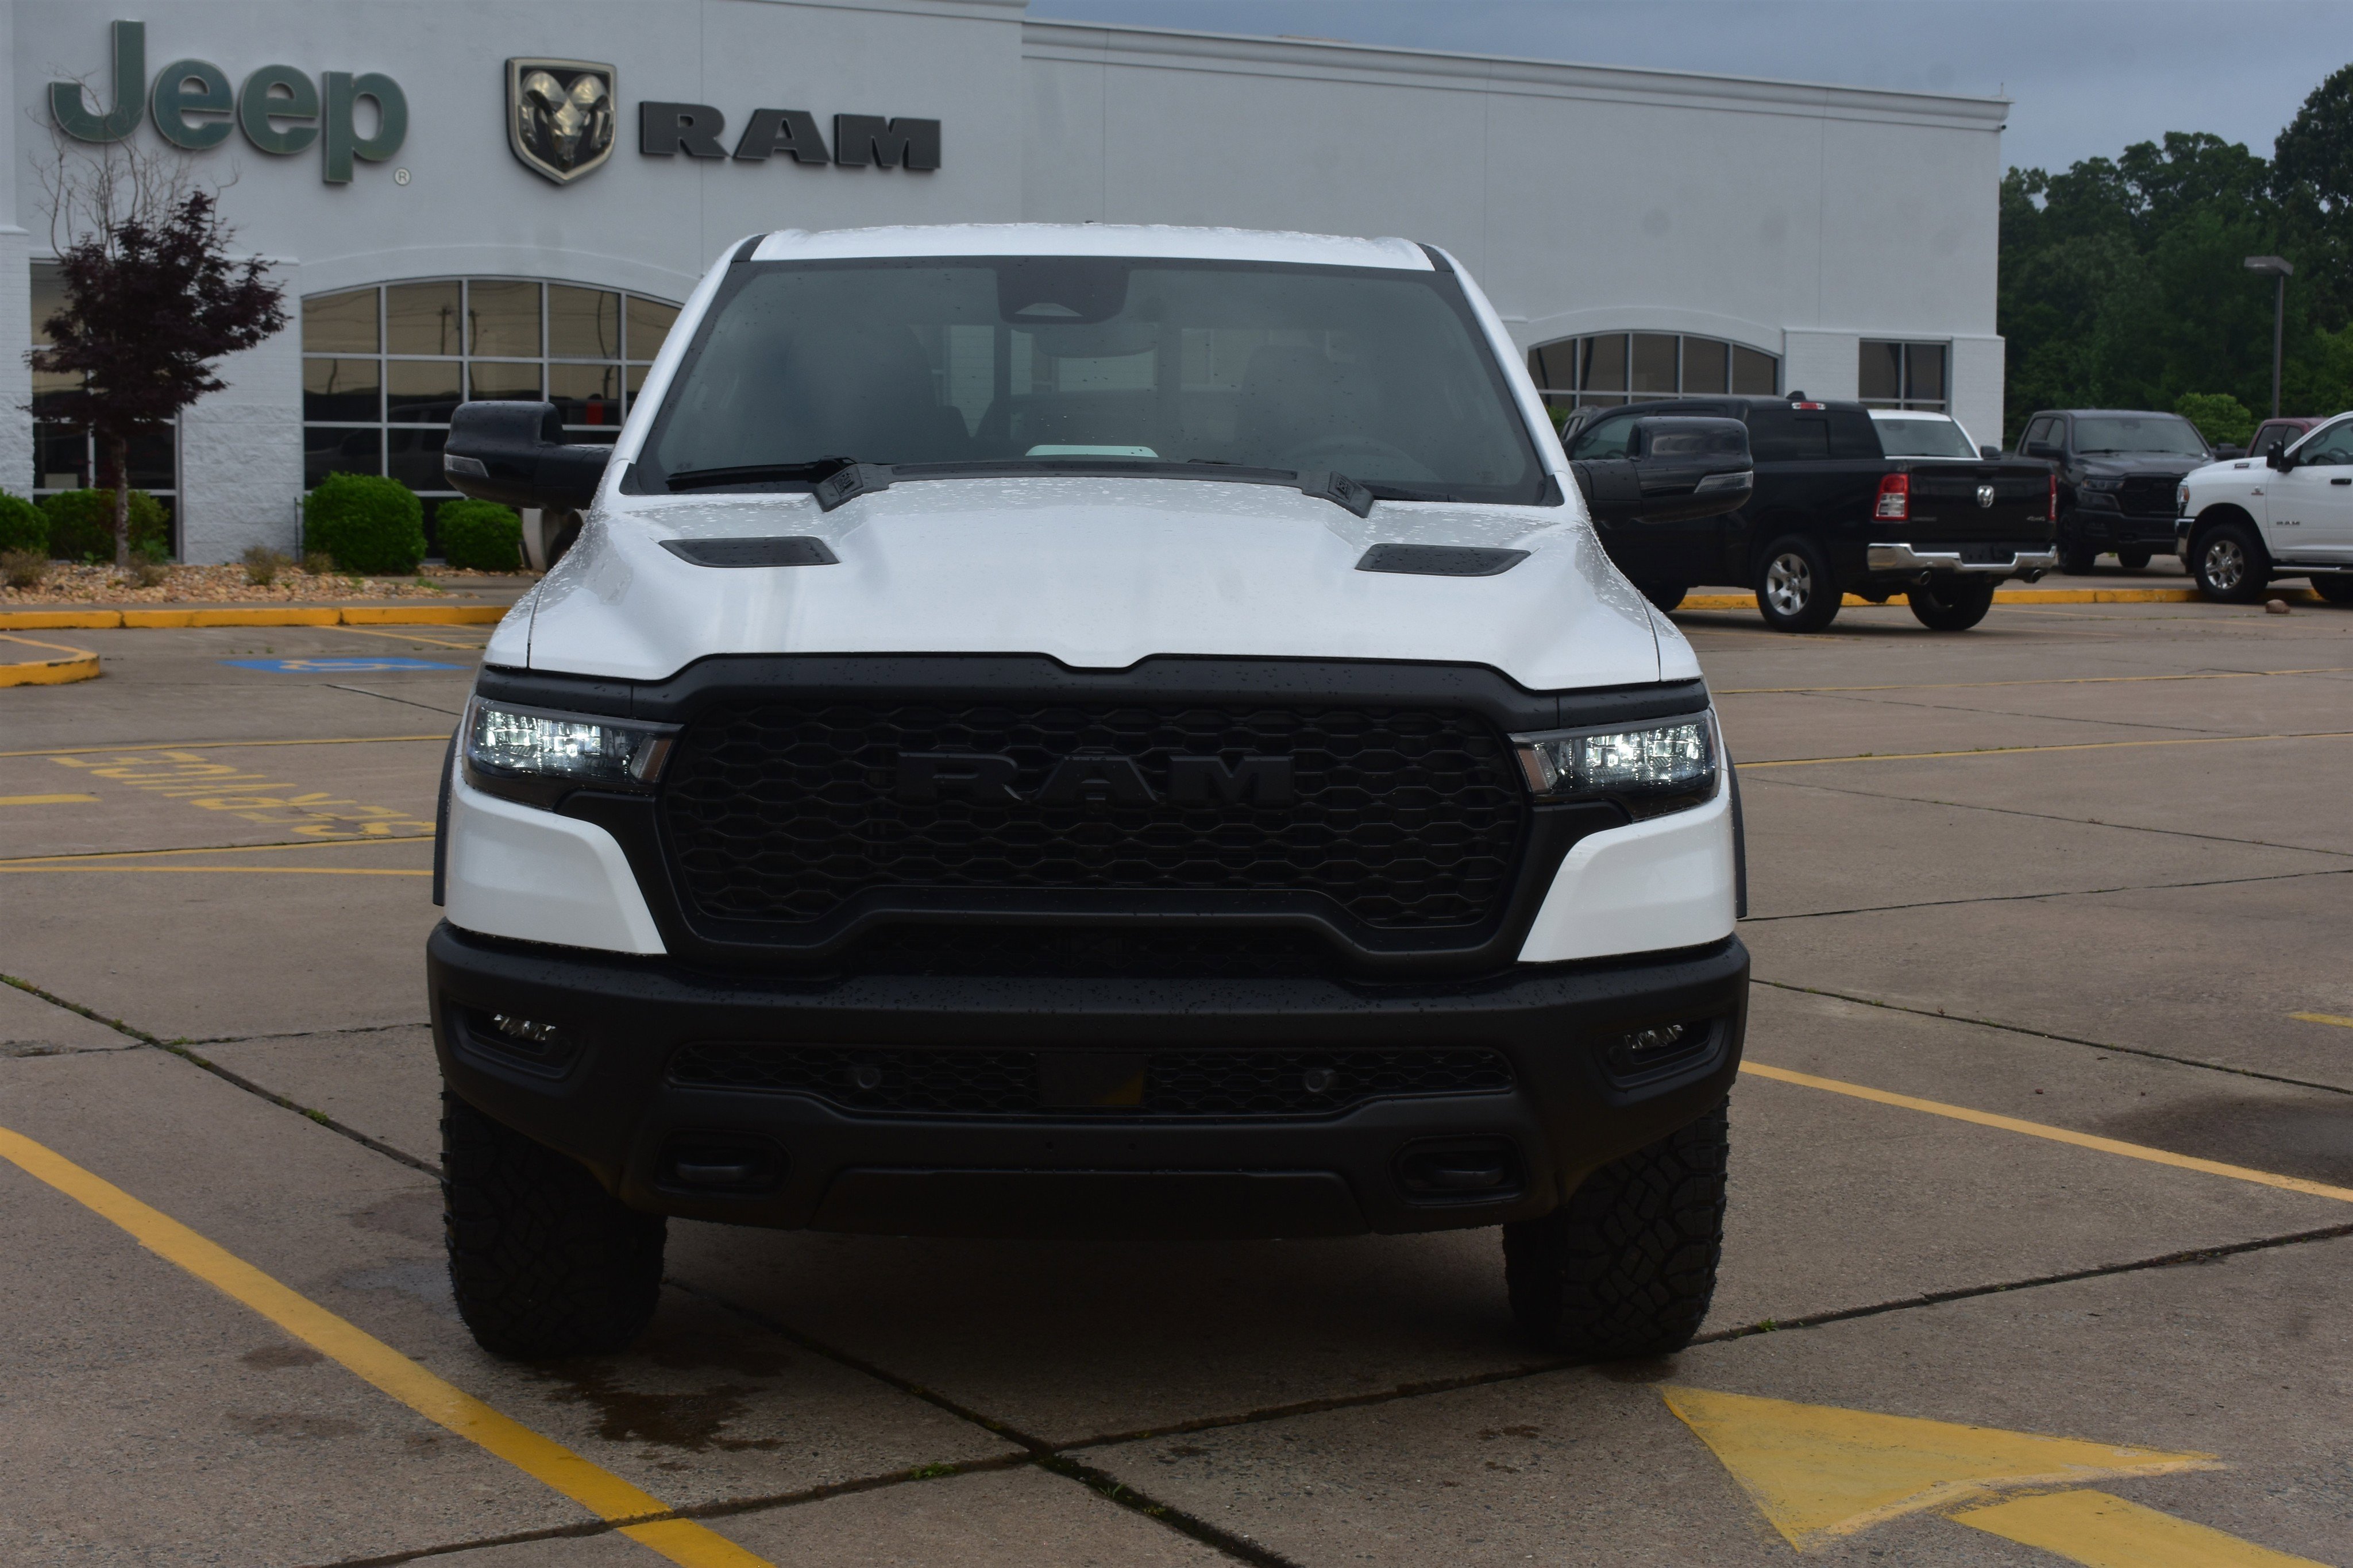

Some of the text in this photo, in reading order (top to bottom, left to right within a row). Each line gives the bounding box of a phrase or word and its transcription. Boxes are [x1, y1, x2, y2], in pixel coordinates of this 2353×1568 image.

[49, 20, 409, 183] Jeep
[640, 101, 941, 169] RAM
[48, 751, 436, 836] SERVICE
[897, 752, 1295, 802] RAM
